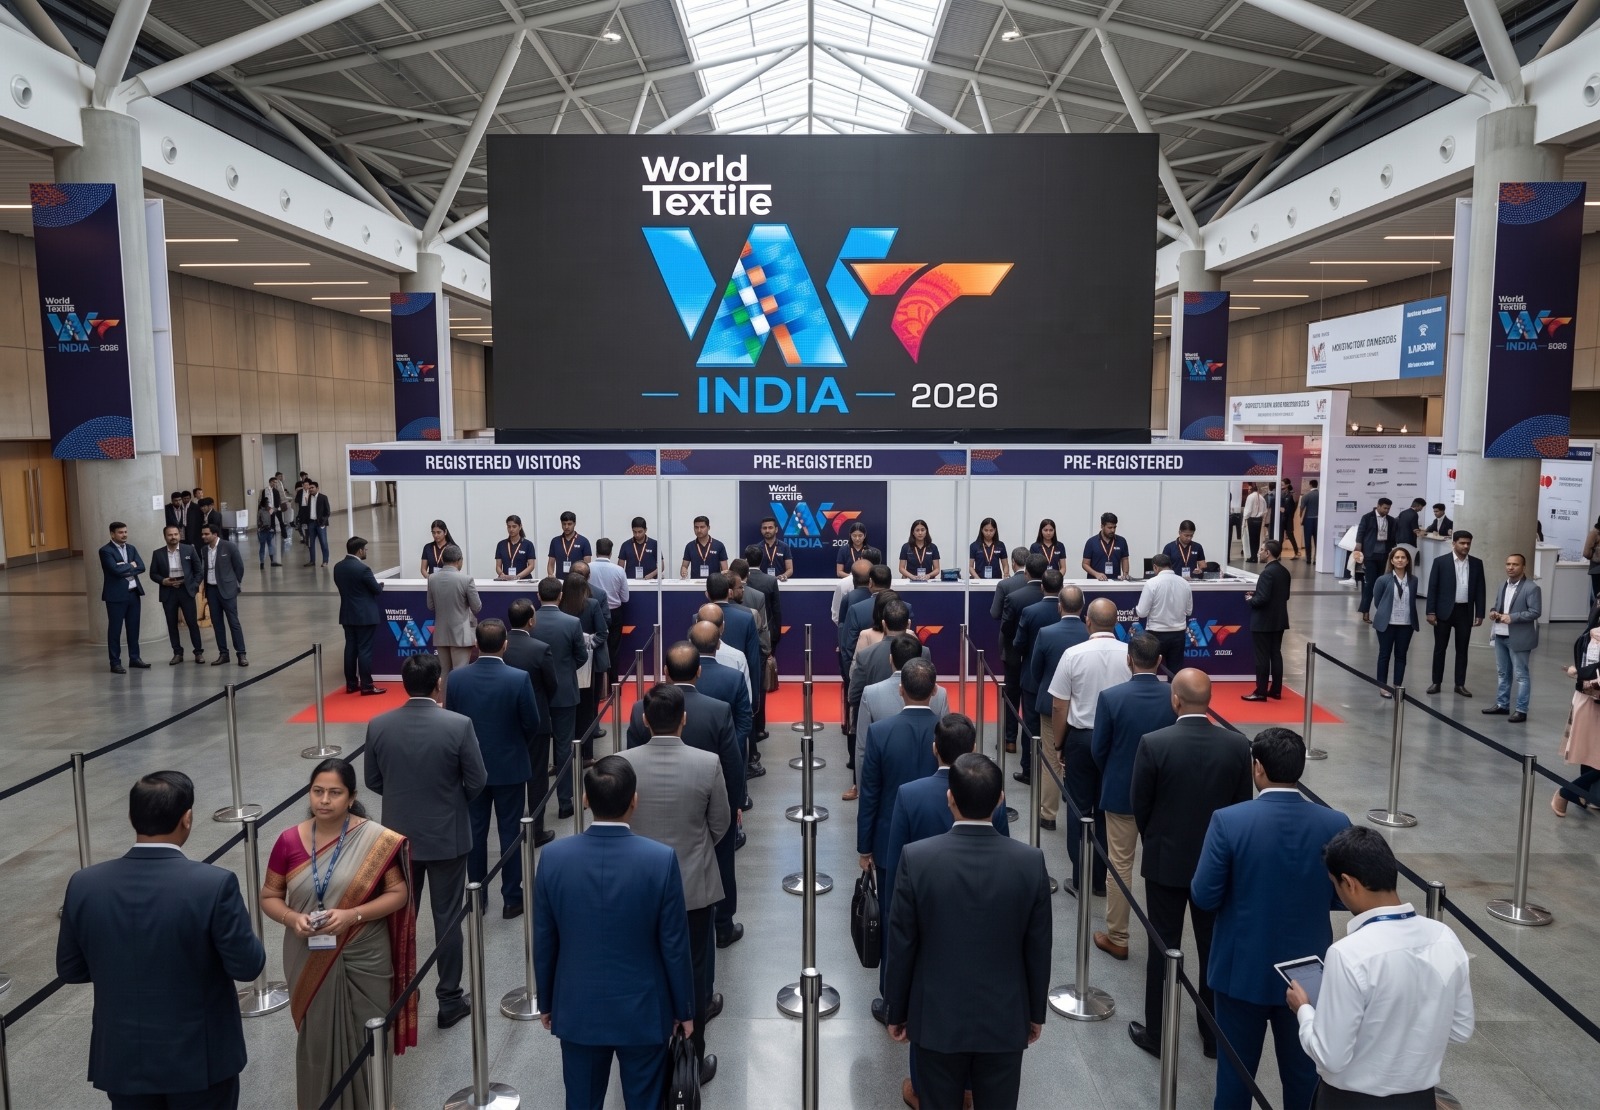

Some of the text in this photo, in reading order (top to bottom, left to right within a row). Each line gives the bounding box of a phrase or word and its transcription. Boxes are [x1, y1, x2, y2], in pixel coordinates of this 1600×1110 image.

[642, 155, 748, 182] World
[642, 184, 772, 216] Textile
[1498, 295, 1524, 303] World
[46, 304, 75, 312] Textile
[58, 343, 90, 352] INDIA
[1506, 341, 1538, 351] INDIA
[698, 377, 998, 413] INDIA 2026
[425, 455, 581, 470] REGISTERED VISITORS
[753, 454, 873, 469] PRE-REGISTERED
[1063, 455, 1184, 470] PRE-REGISTERED
[769, 484, 797, 492] World
[769, 493, 803, 501] Textile
[1184, 649, 1210, 657] NDIA
